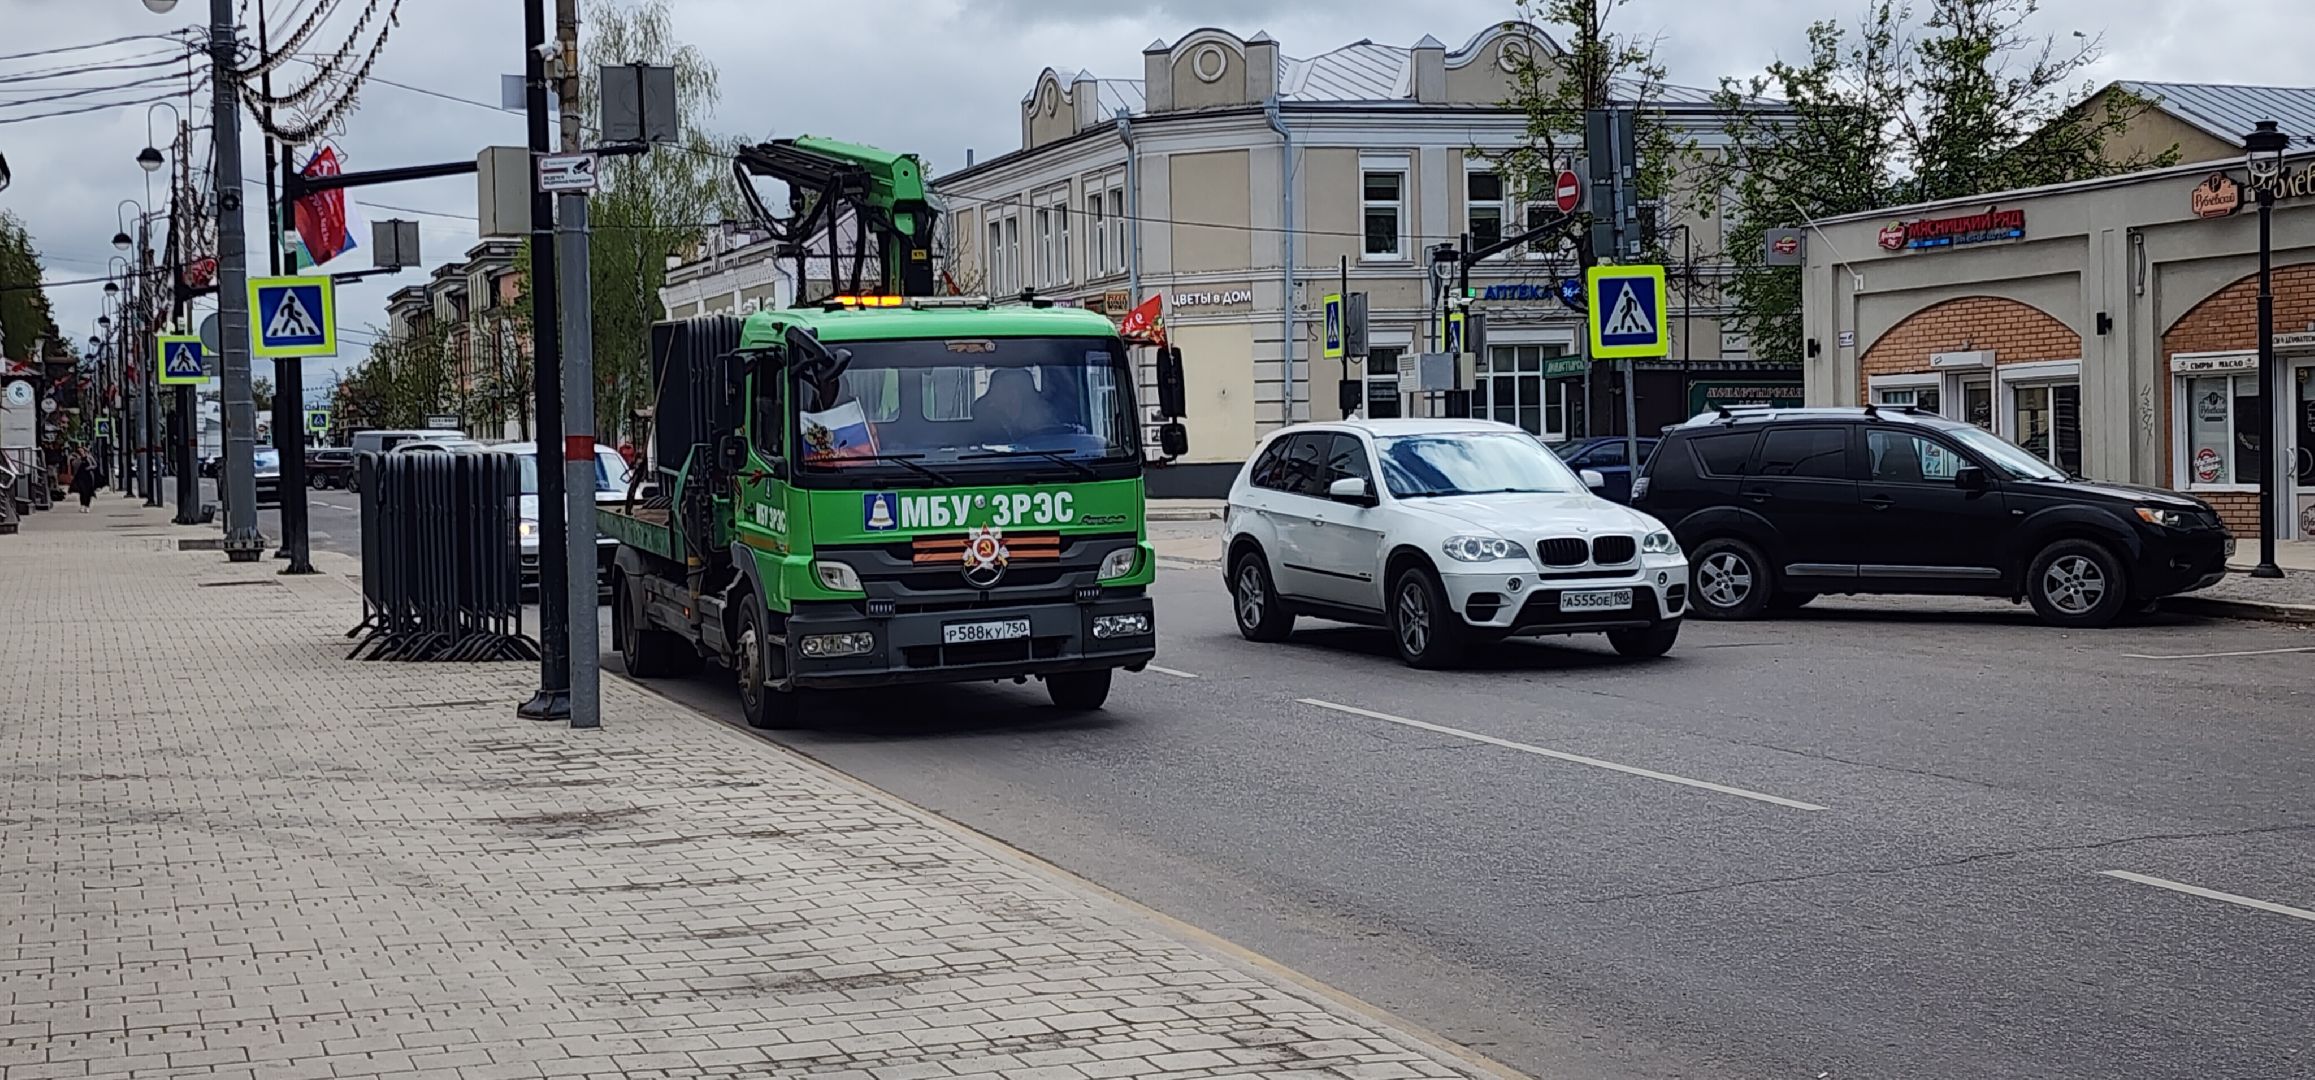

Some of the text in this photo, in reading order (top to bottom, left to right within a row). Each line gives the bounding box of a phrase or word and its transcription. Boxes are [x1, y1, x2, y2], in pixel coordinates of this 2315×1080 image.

[1908, 214, 1991, 238] МЯСНИЦКИЙ
[1992, 211, 2022, 229] РЯД
[1171, 292, 1211, 307] ЦВЕТЫ
[1222, 290, 1252, 305] ДОМ
[1484, 285, 1553, 300] АПТЕКА
[756, 502, 786, 533] МБУ ЗРЭС
[901, 491, 1074, 529] МБУ ЗРЭС
[1566, 591, 1630, 607] А555ОЕ 190
[949, 622, 1027, 641] Р588КУ 750
